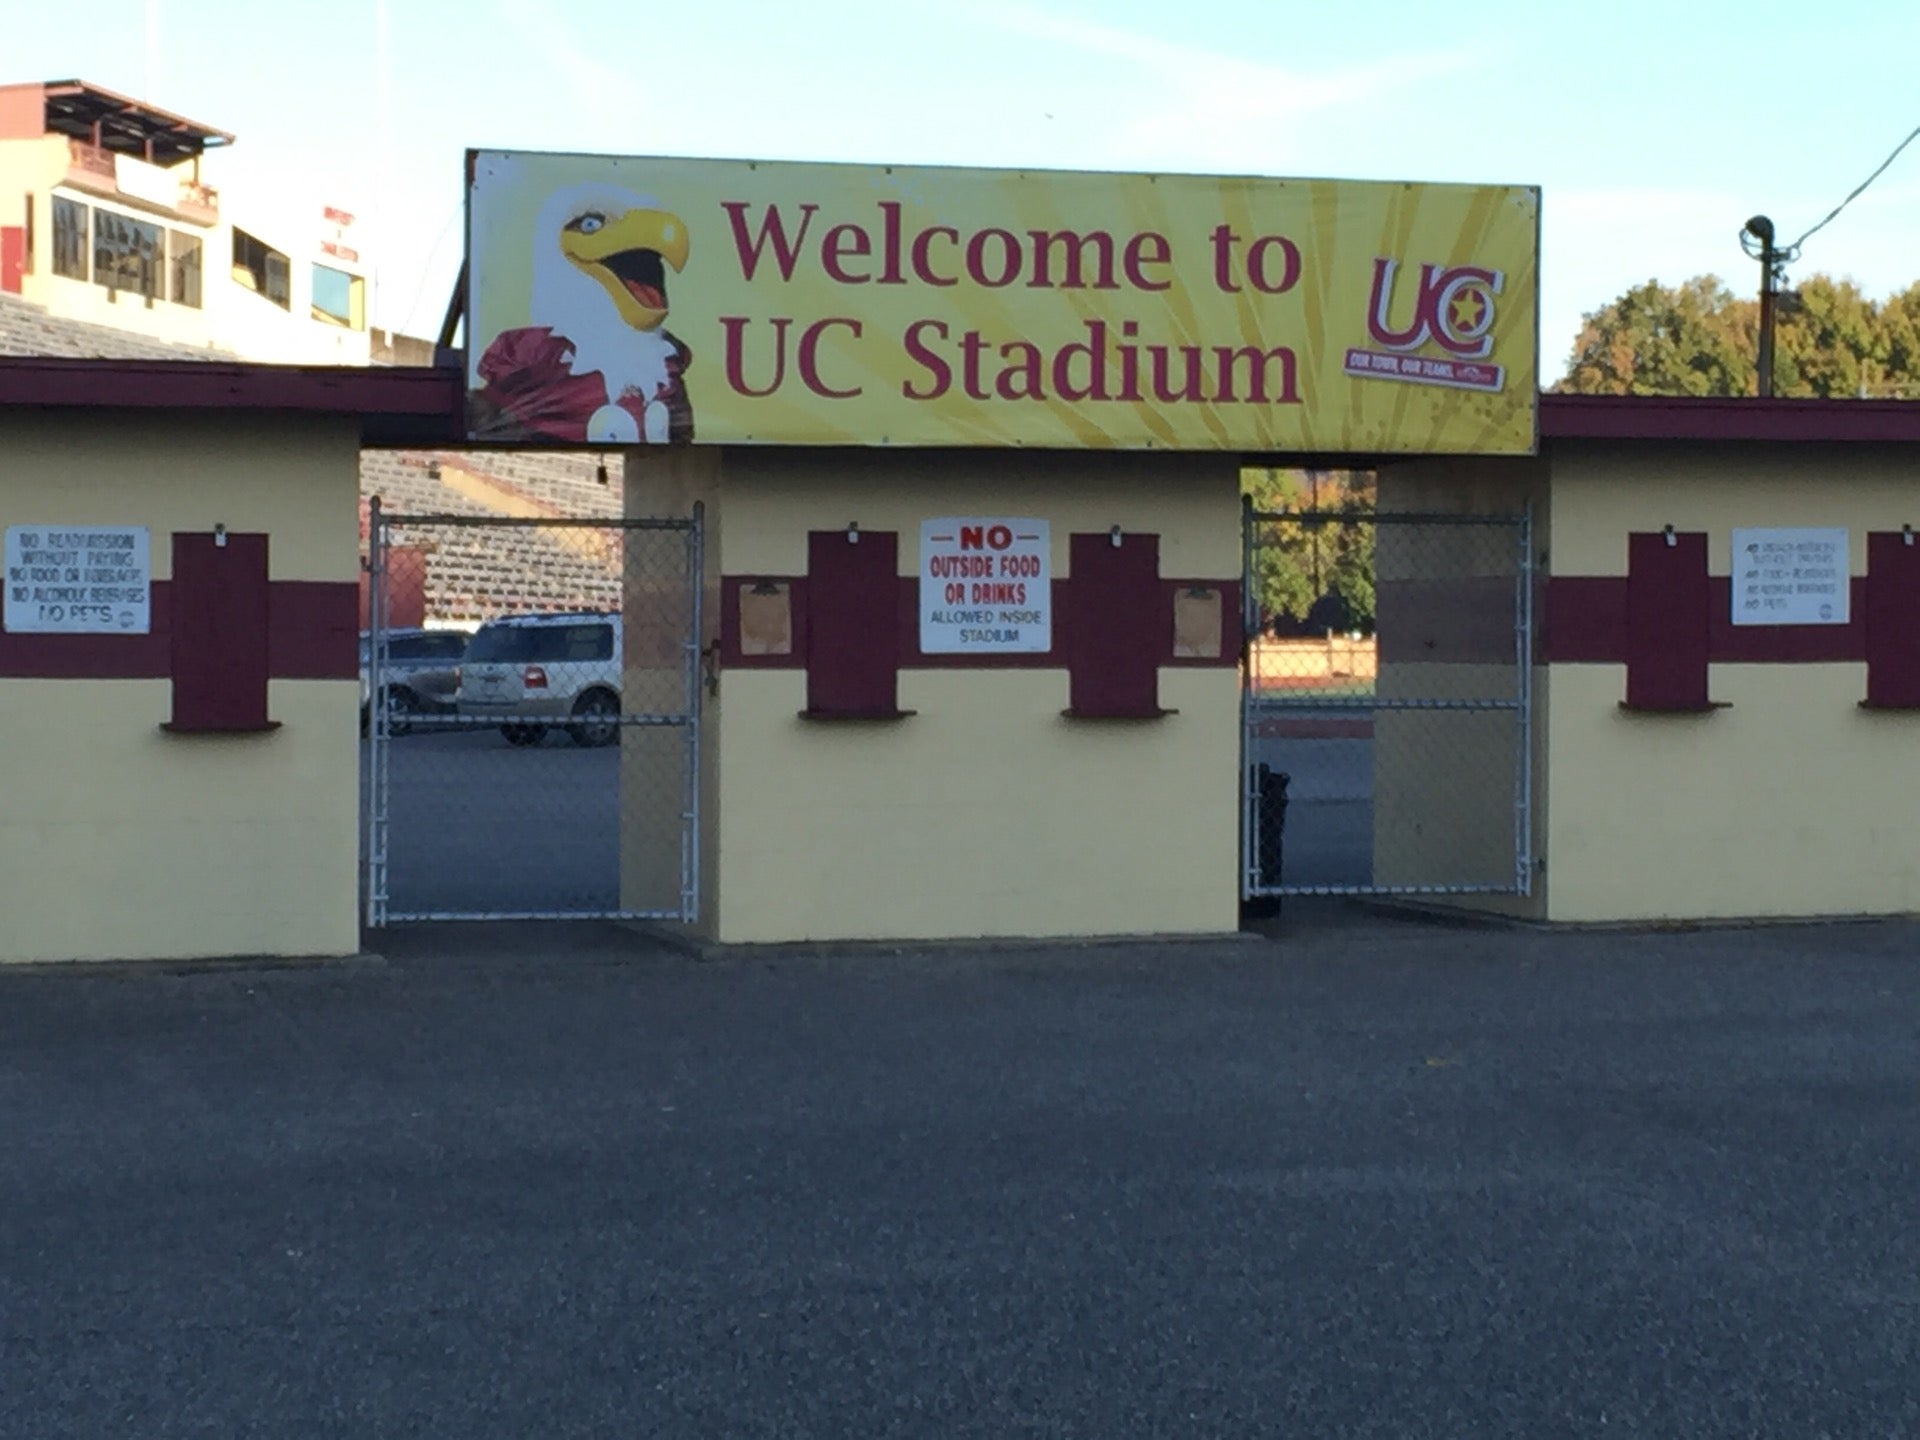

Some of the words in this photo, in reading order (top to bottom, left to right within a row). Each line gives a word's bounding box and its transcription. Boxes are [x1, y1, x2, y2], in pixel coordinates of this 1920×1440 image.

[720, 201, 1172, 291] Welcome
[1209, 224, 1302, 294] to
[1367, 257, 1504, 360] UC
[719, 317, 863, 398] UC
[902, 319, 1303, 404] Stadium
[960, 524, 1013, 551] NO
[930, 555, 993, 578] OUTSIDE
[1001, 555, 1041, 578] FOOD
[945, 583, 965, 605] OR
[972, 583, 1026, 605] DRINKS
[930, 610, 994, 624] ALLOWED
[1001, 610, 1041, 624] INSIDE
[960, 629, 1019, 643] STADIUM
